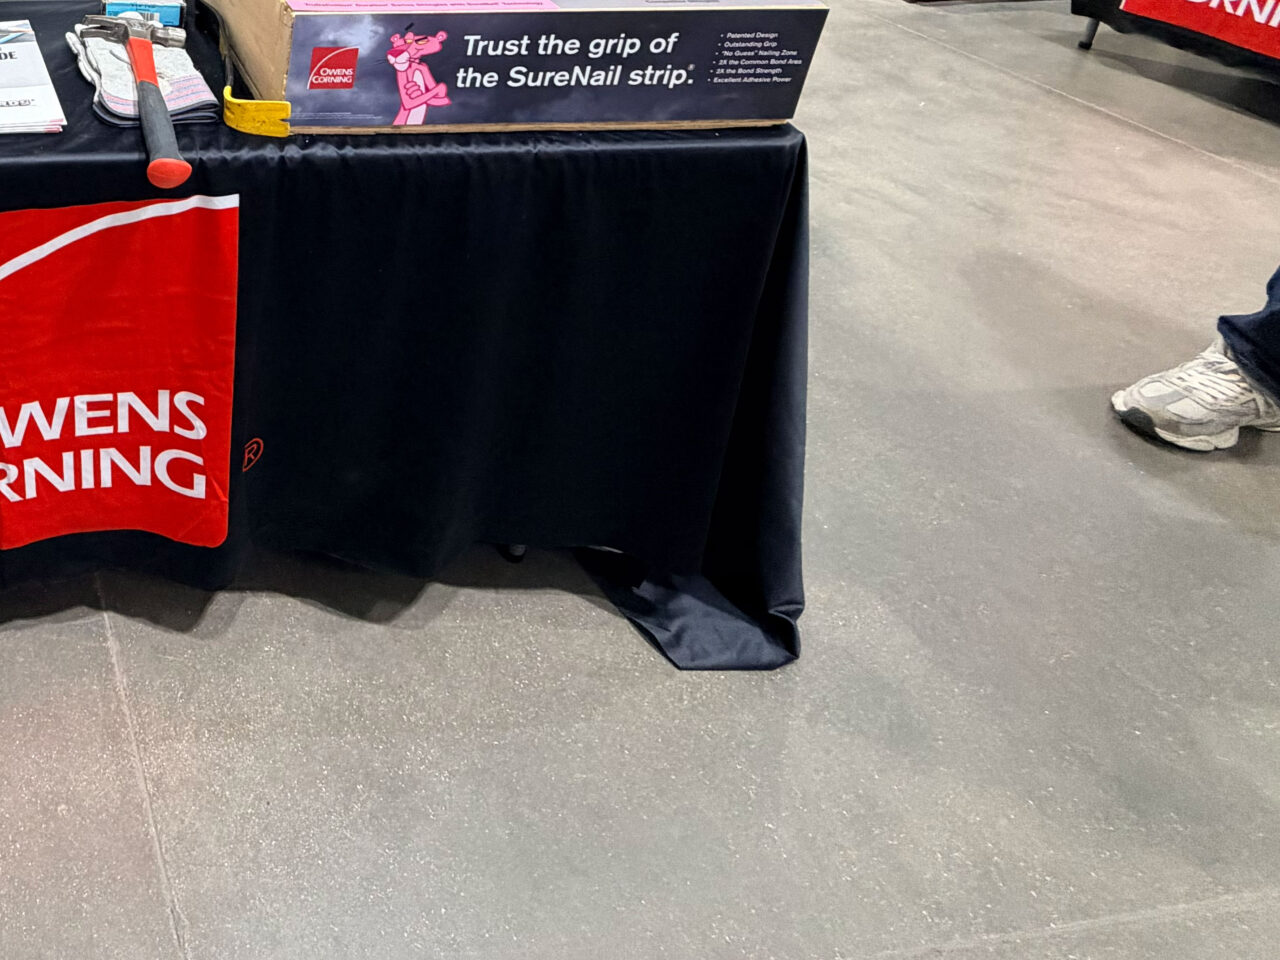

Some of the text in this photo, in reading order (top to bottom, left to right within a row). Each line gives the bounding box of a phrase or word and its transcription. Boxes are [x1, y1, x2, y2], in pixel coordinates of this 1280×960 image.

[726, 31, 778, 39] Patented Design
[463, 31, 679, 58] Trust the grip of
[723, 40, 778, 48] Outstanding Grip
[320, 68, 354, 77] OWENS
[456, 63, 694, 89] the SureNail strip.
[312, 74, 352, 84] CORNING
